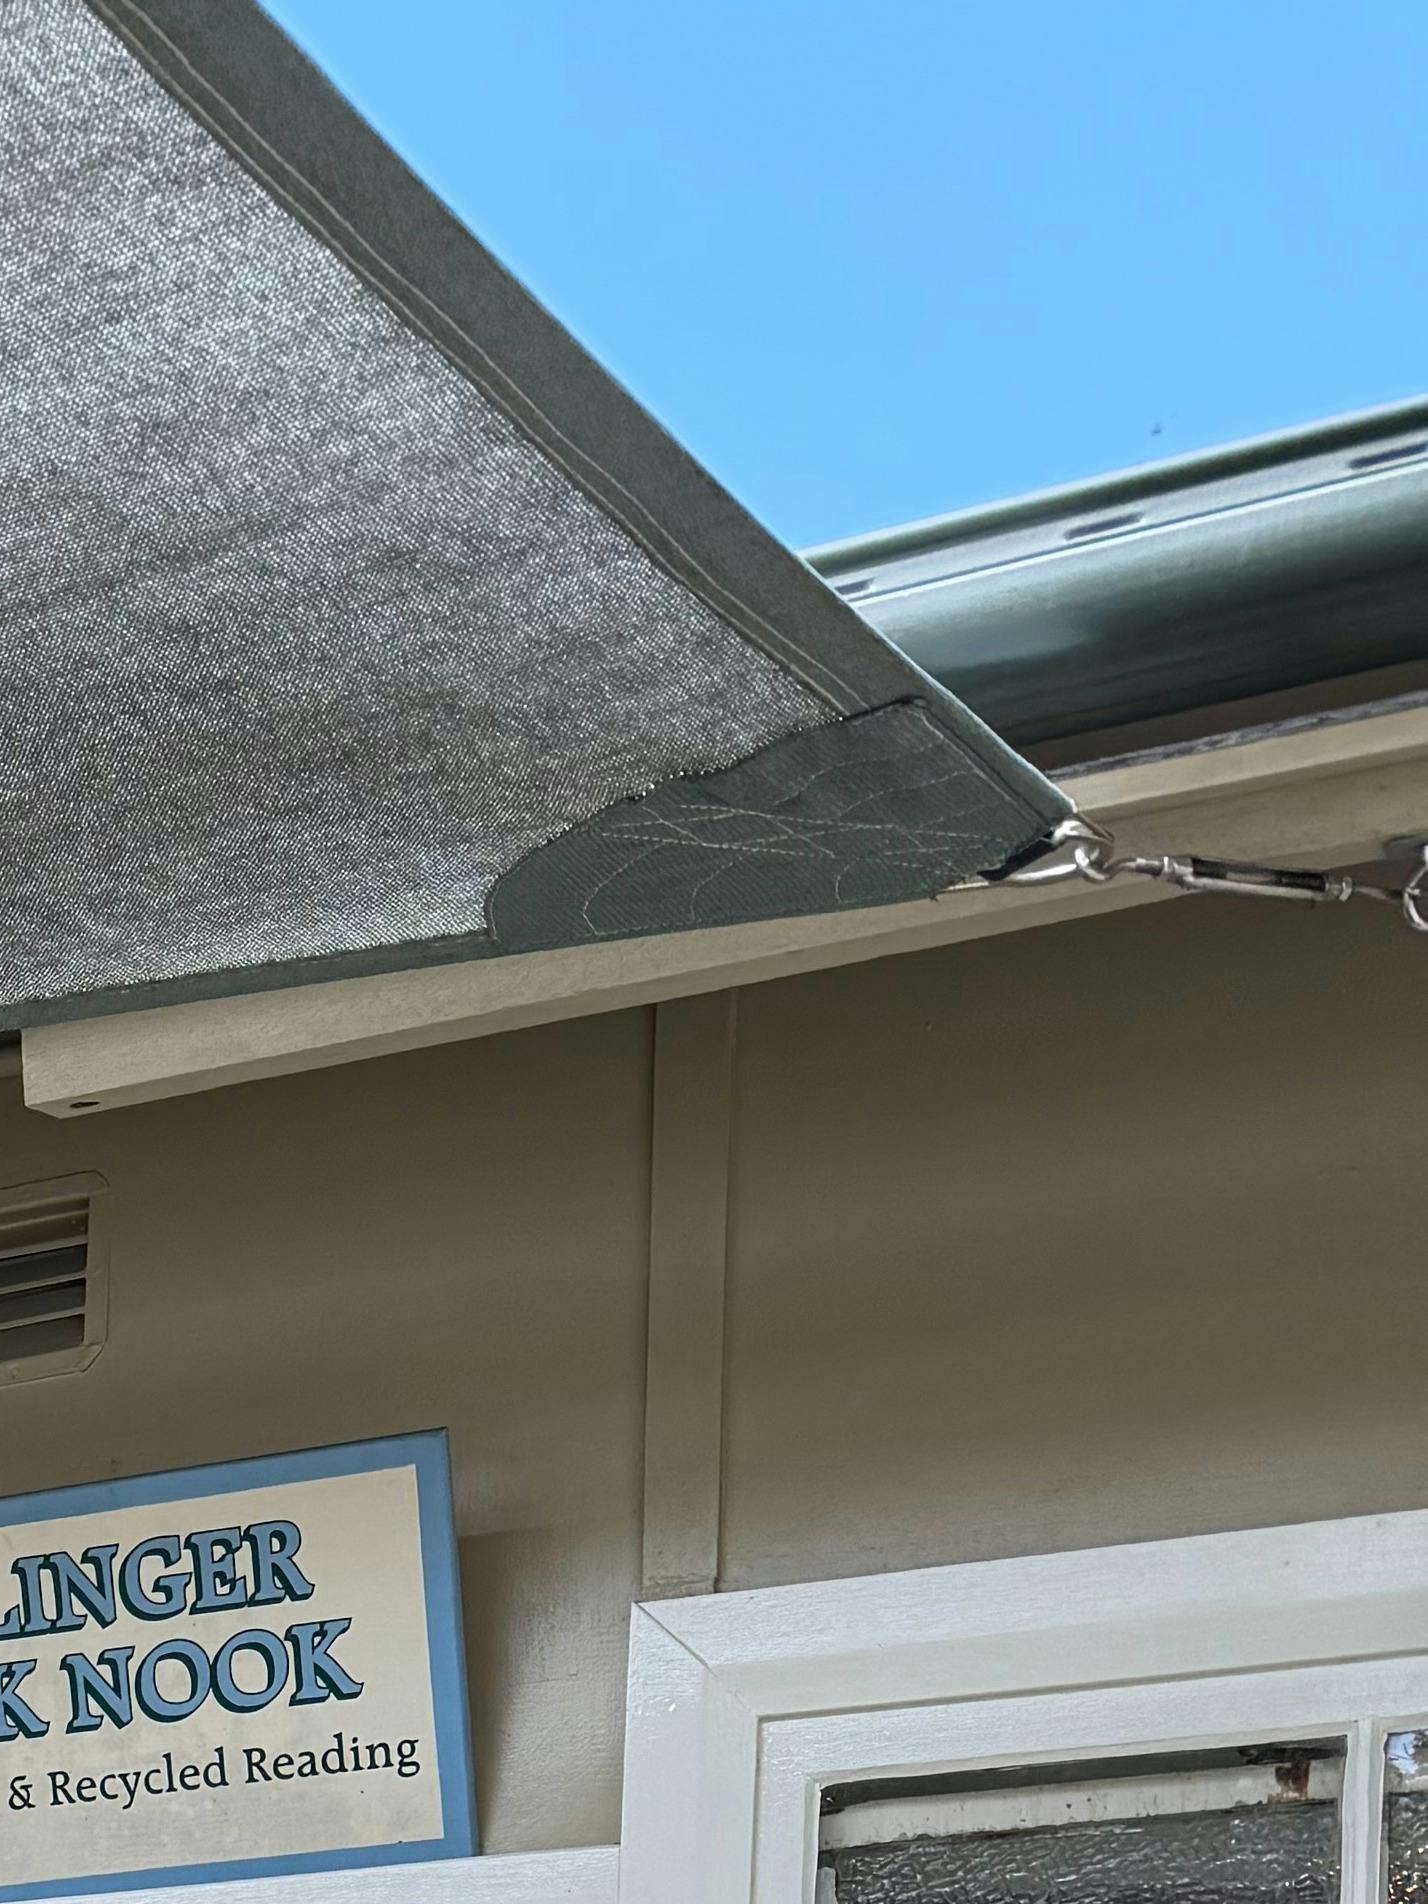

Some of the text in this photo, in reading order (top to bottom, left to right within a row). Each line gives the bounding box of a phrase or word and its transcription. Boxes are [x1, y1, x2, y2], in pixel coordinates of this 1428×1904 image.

[62, 1616, 365, 1734] NOOK
[8, 1775, 37, 1811] &
[49, 1744, 228, 1819] Recycled
[242, 1732, 422, 1785] Reading
